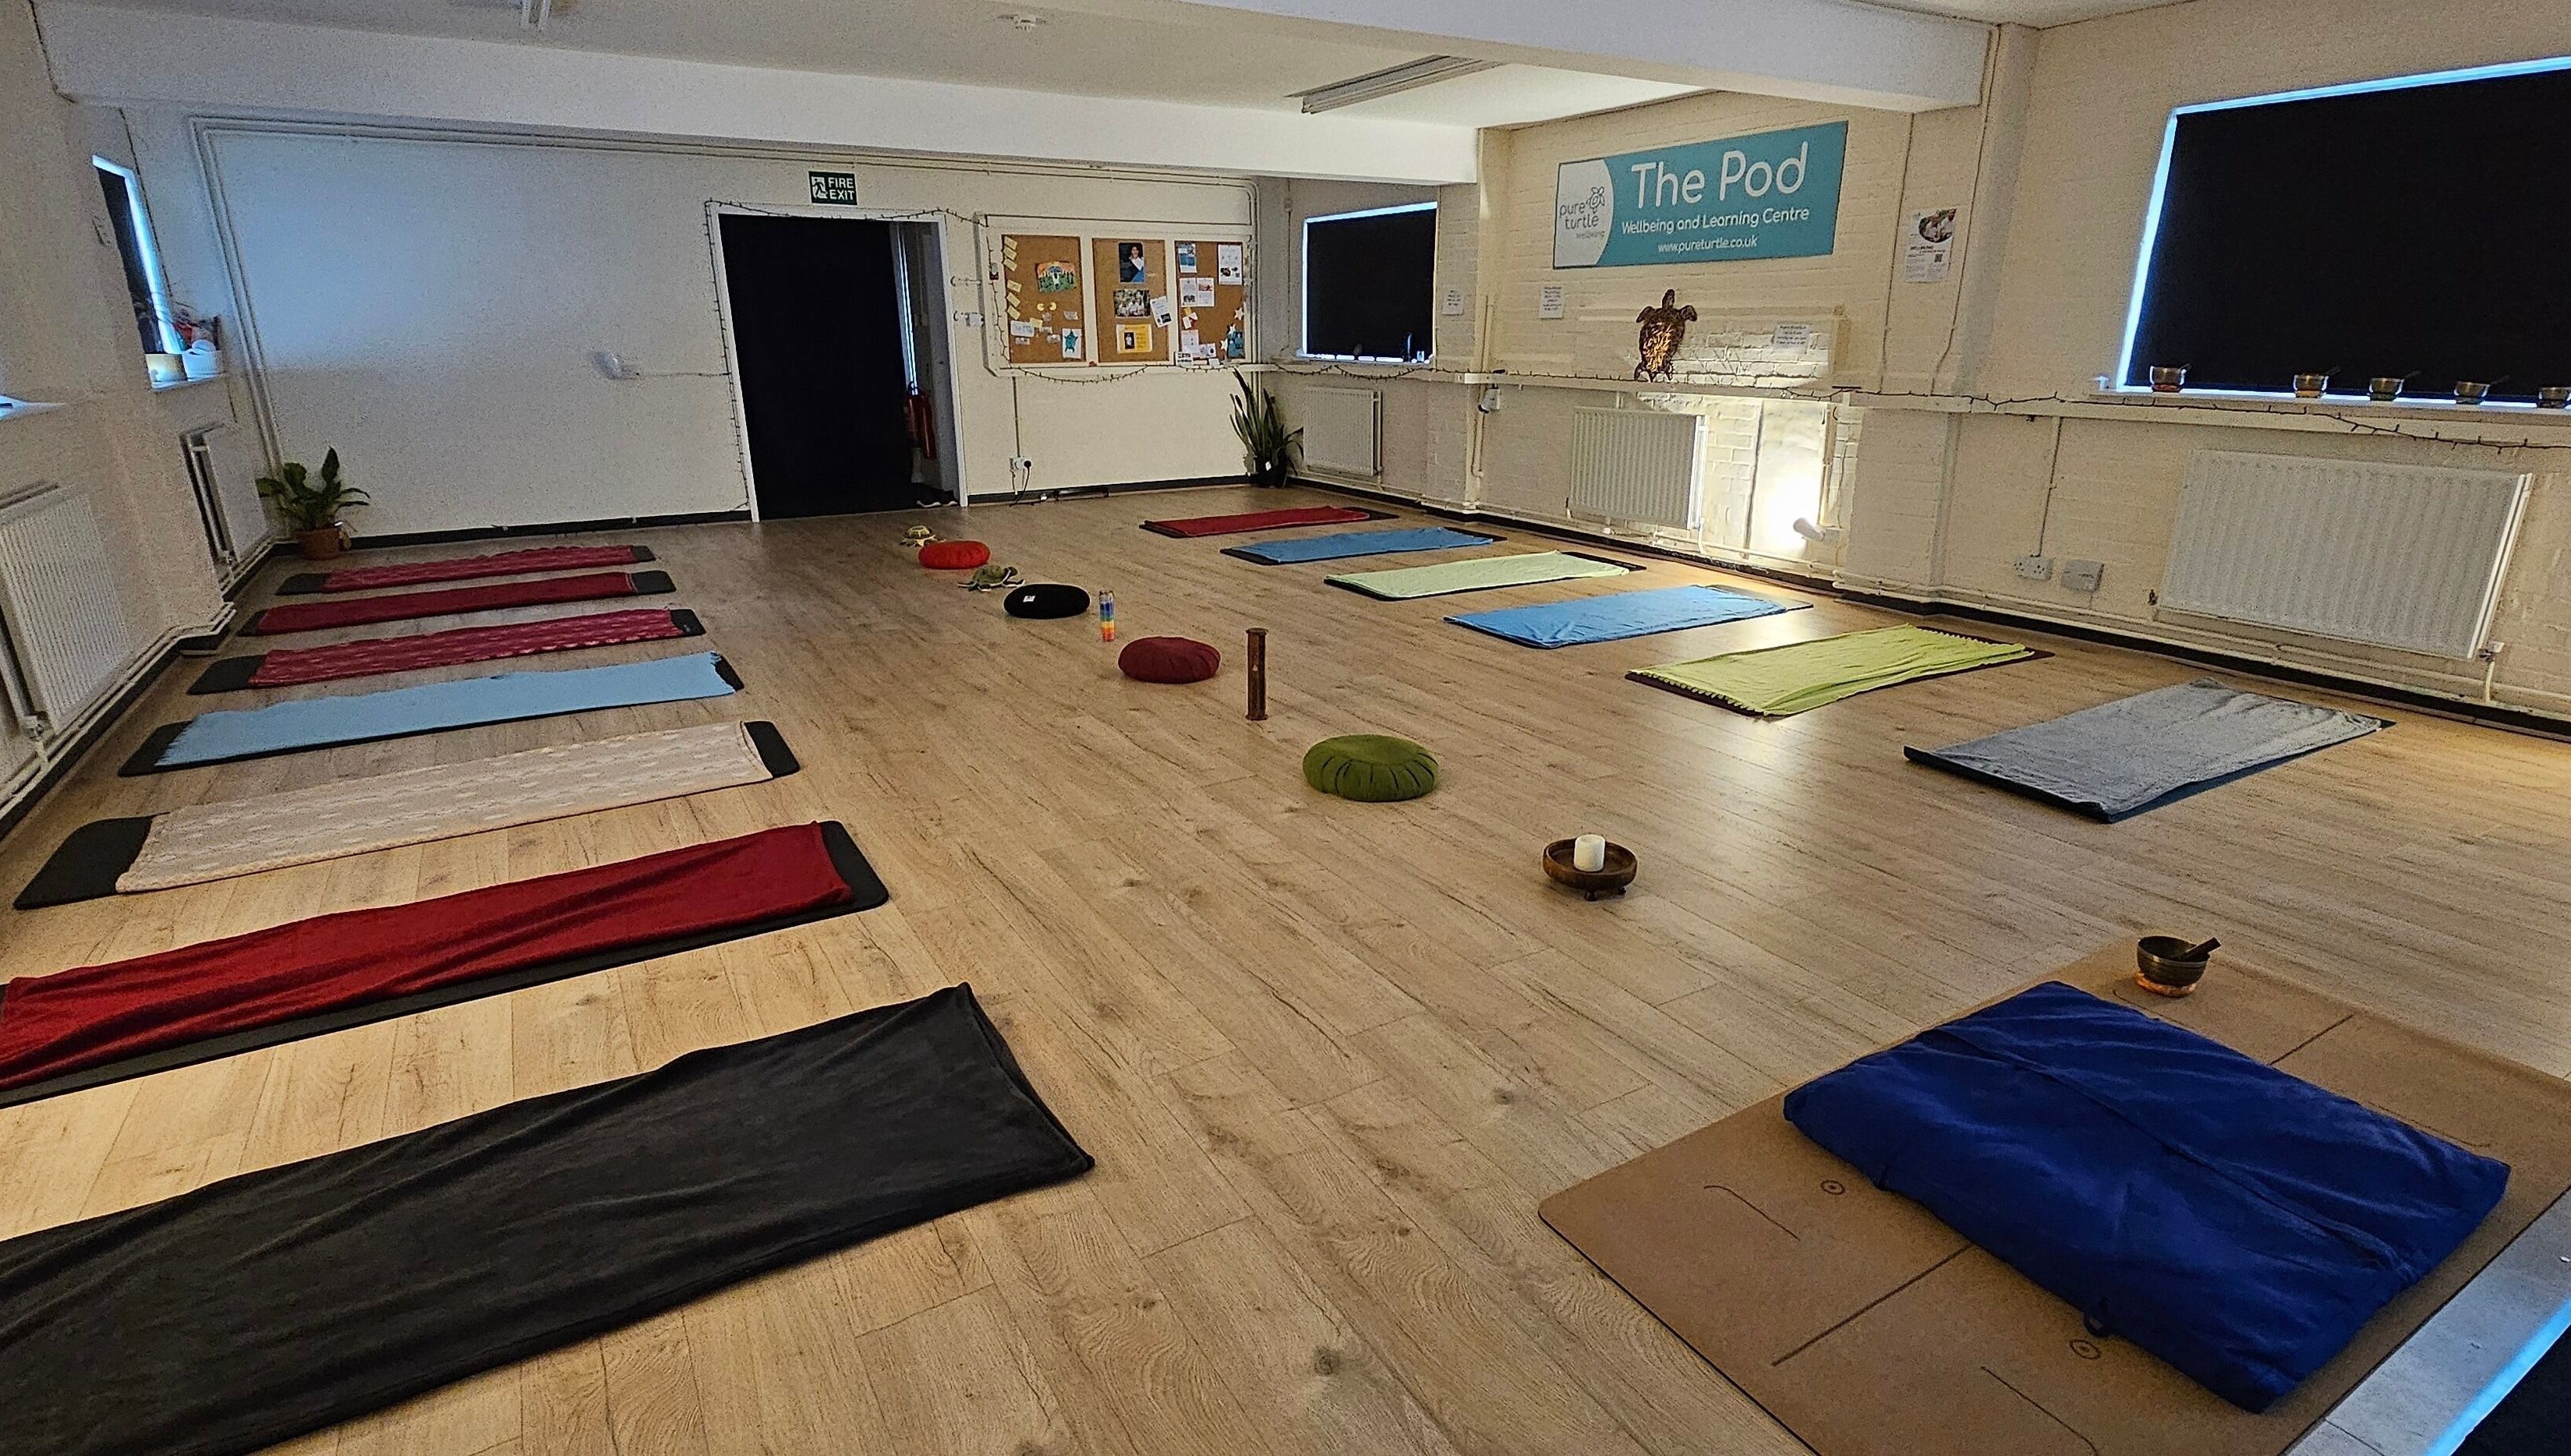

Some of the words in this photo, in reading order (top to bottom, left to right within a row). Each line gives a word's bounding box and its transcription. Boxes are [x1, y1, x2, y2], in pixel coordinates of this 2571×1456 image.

[828, 177, 854, 189] FIRE
[1632, 161, 1705, 209] The
[1719, 141, 1809, 201] Pod
[829, 189, 855, 200] EXIT
[1559, 203, 1586, 219] pure
[1565, 214, 1600, 229] turtle
[1621, 218, 1674, 235] Wellbeing
[1677, 214, 1700, 231] and
[1703, 210, 1759, 228] Learning
[1763, 207, 1809, 223] Centre
[1657, 235, 1759, 254] www.pureturtle.co.uk
